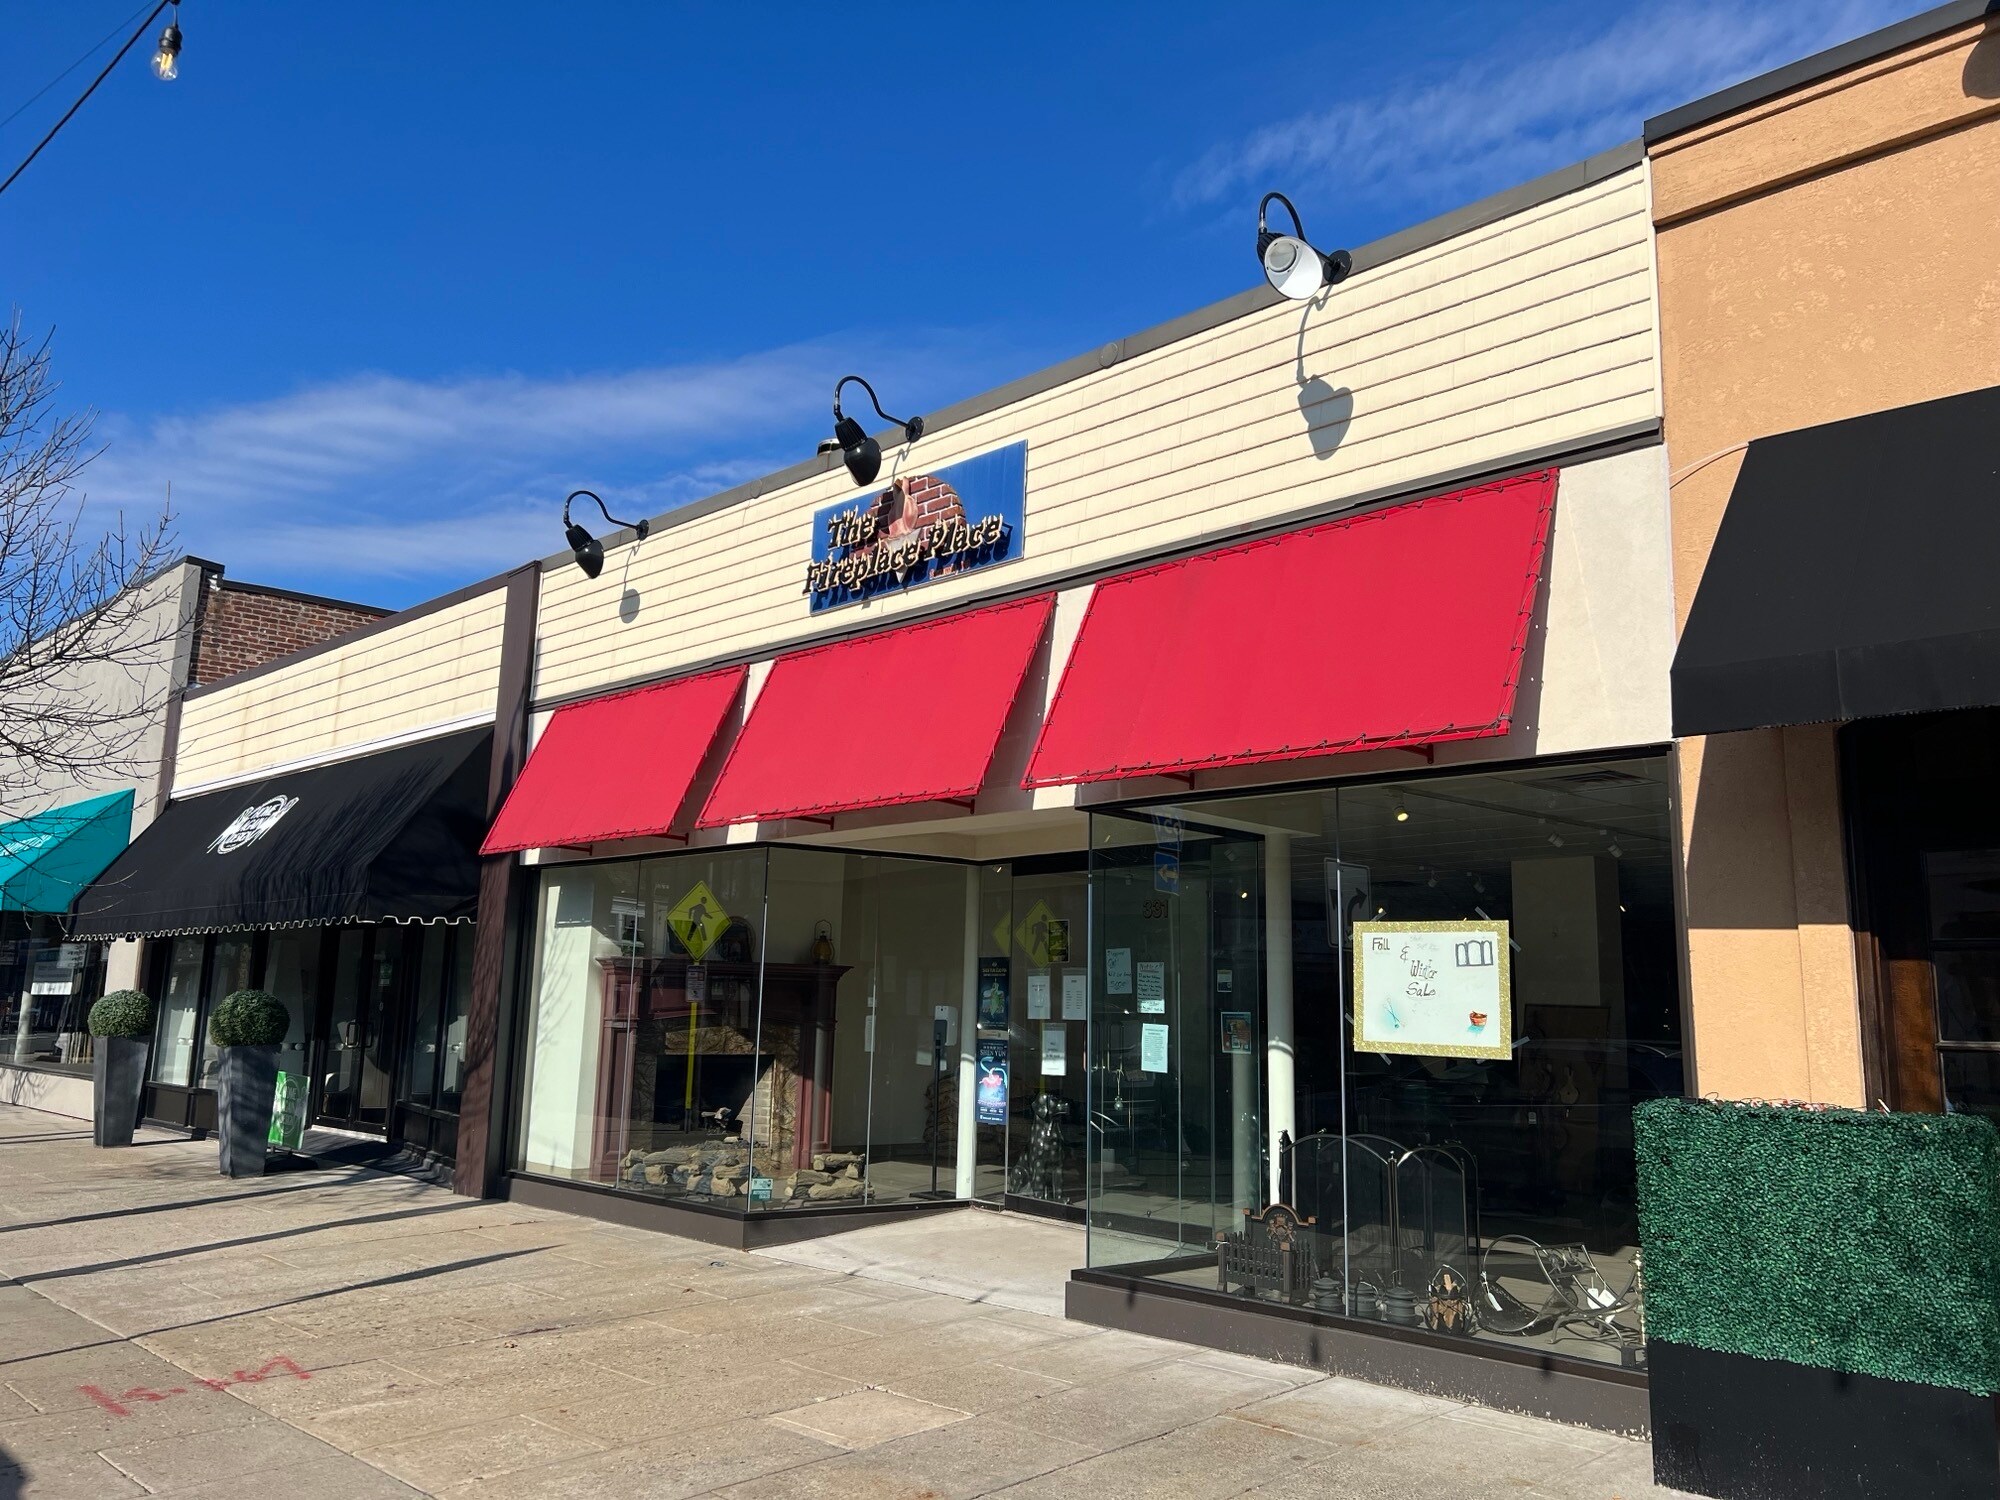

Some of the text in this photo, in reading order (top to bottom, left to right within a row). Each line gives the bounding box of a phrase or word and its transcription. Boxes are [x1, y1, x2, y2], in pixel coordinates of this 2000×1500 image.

[828, 505, 877, 550] The
[802, 513, 1004, 594] Fireplace Place
[1372, 937, 1390, 951] Fall
[1400, 945, 1409, 963] &
[1405, 981, 1436, 997] Sale
